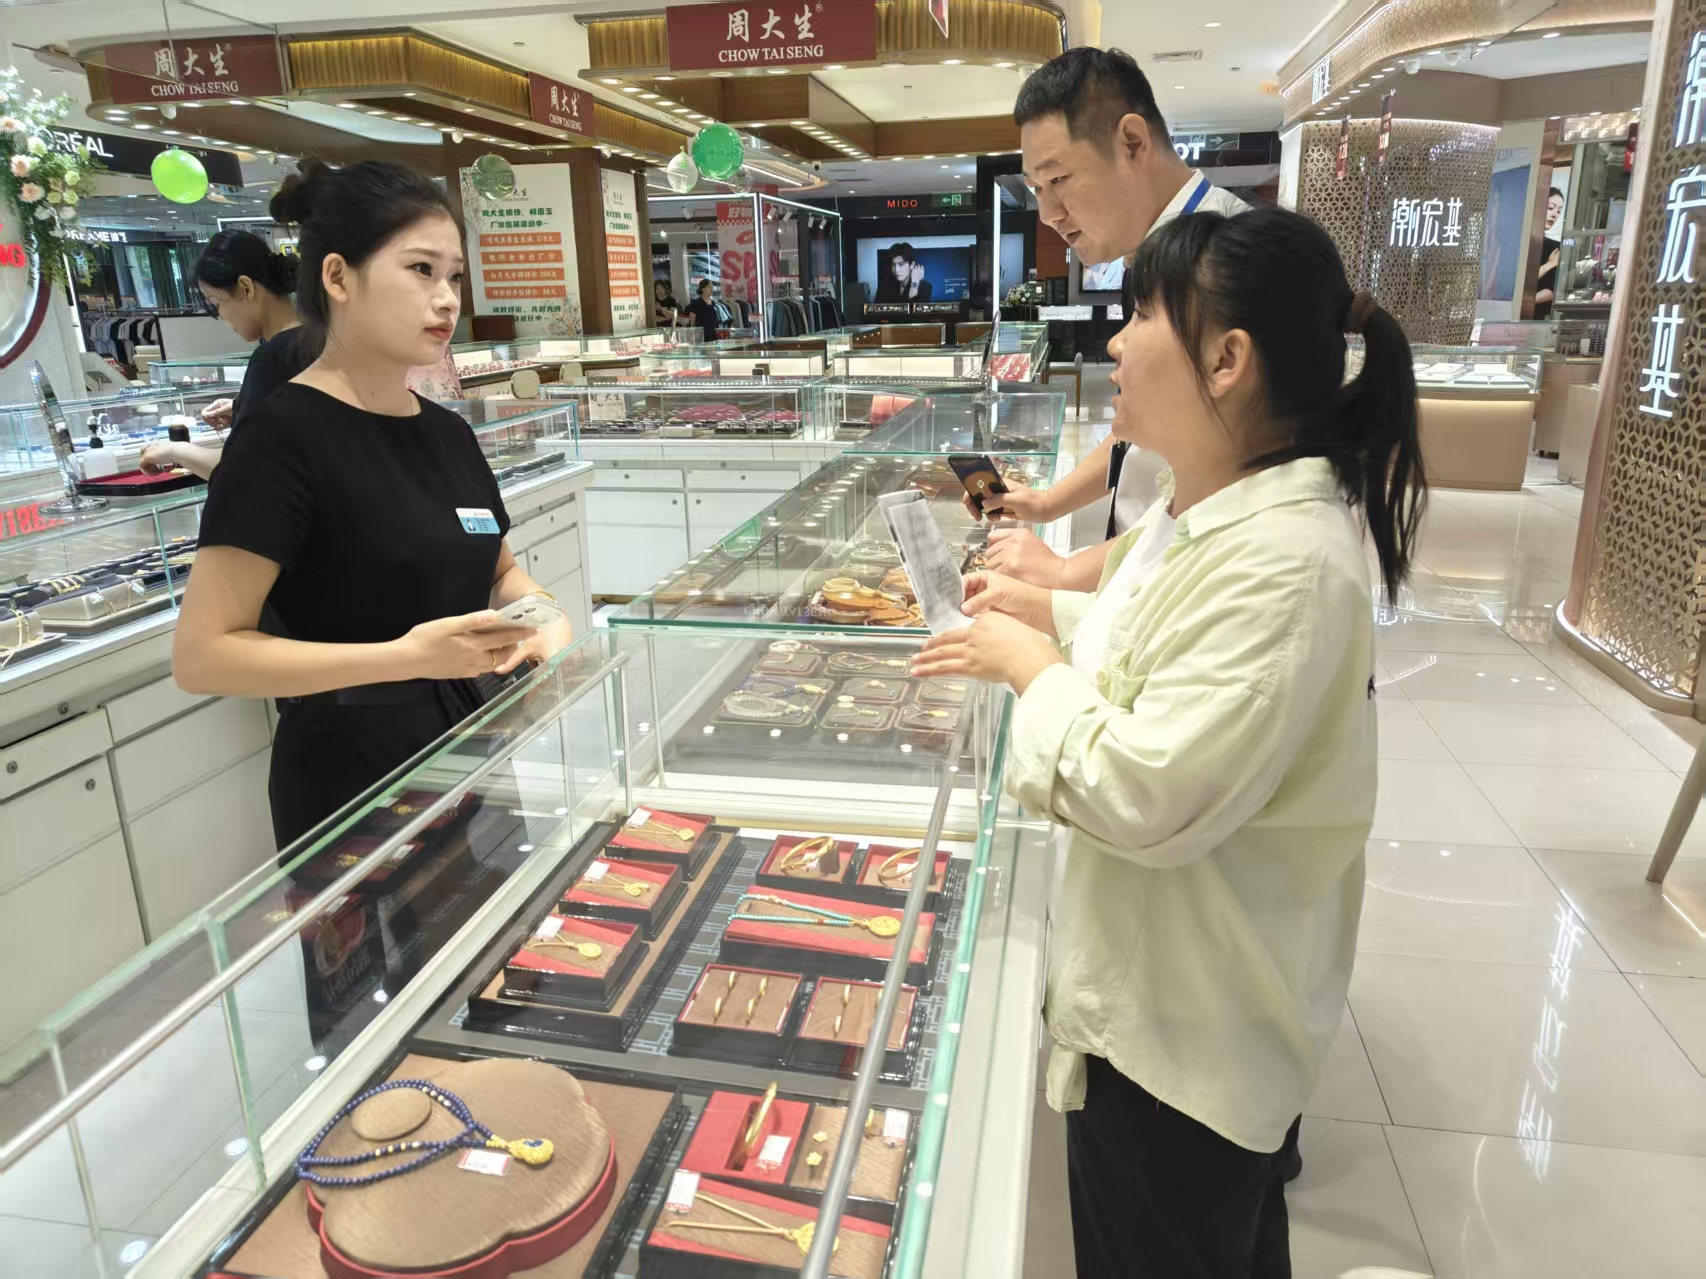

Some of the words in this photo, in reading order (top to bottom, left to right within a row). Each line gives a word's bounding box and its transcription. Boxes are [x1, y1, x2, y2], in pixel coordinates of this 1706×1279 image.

[726, 4, 815, 42] 周大生
[153, 43, 229, 77] 周大生
[718, 48, 760, 62] CHOW
[762, 47, 785, 60] TAI
[786, 44, 824, 59] SENG
[151, 83, 185, 97] CHOW
[206, 80, 239, 94] SENG
[550, 85, 579, 117] 周大生
[887, 199, 918, 208] MIDO
[1389, 196, 1463, 247] 潮宏基
